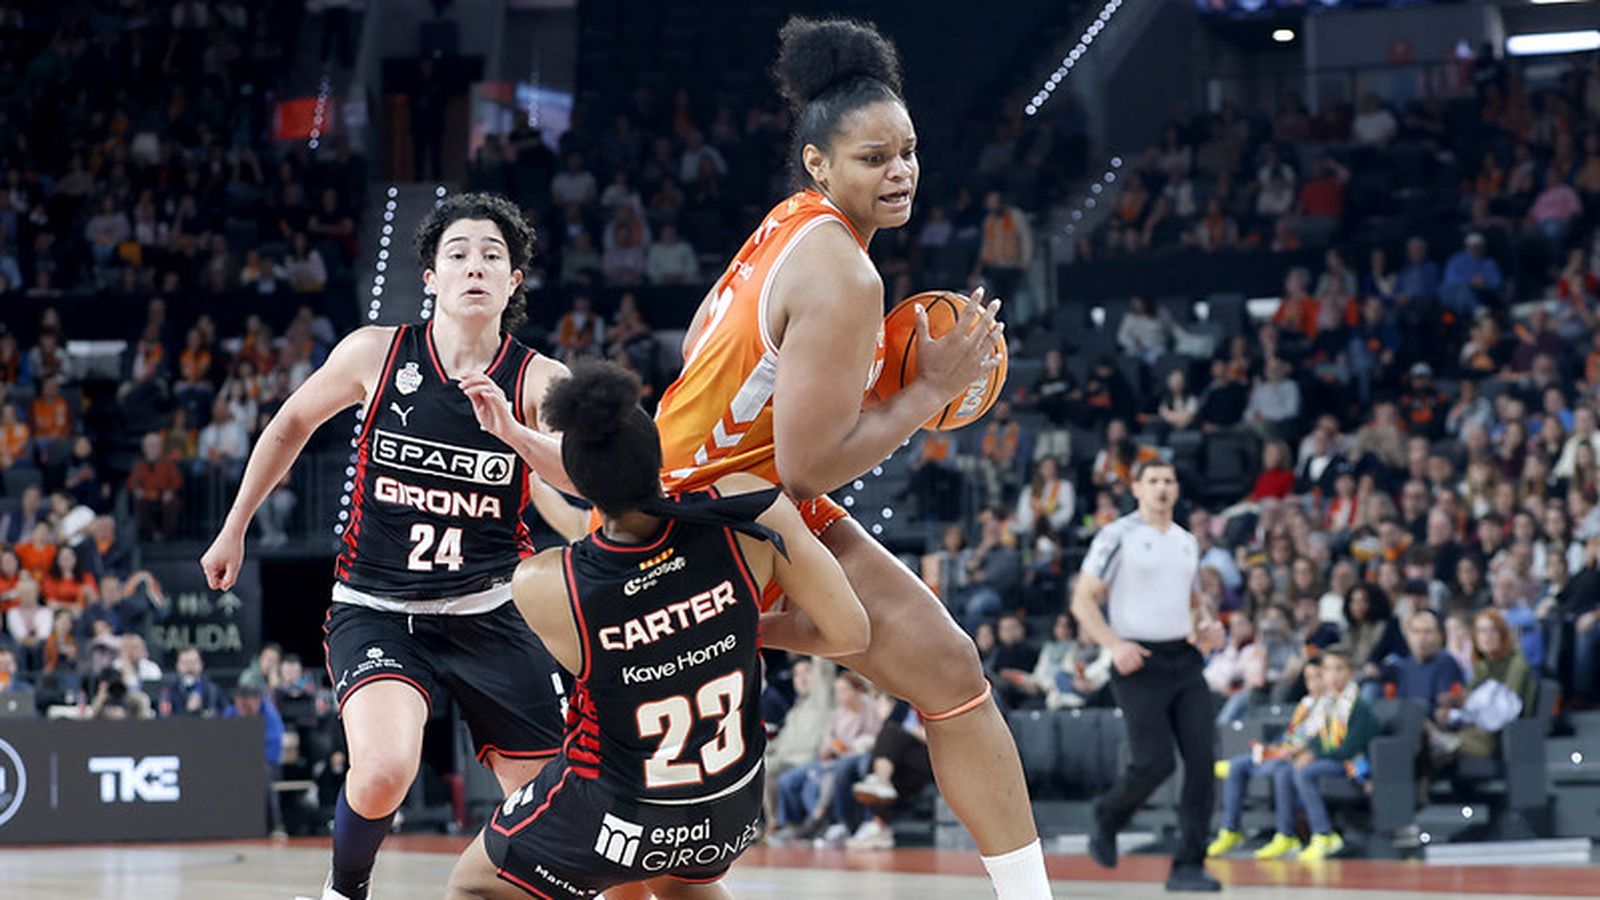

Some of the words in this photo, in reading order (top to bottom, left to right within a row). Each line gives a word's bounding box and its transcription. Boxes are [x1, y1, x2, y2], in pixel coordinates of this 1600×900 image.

[378, 439, 475, 475] SPAR
[374, 476, 501, 518] GIRONA
[407, 523, 464, 572] 24
[598, 580, 738, 651] CARTER
[622, 662, 676, 685] Kave
[677, 633, 737, 670] Home
[636, 670, 745, 789] 23
[88, 756, 180, 802] TKE
[650, 818, 711, 848] espai
